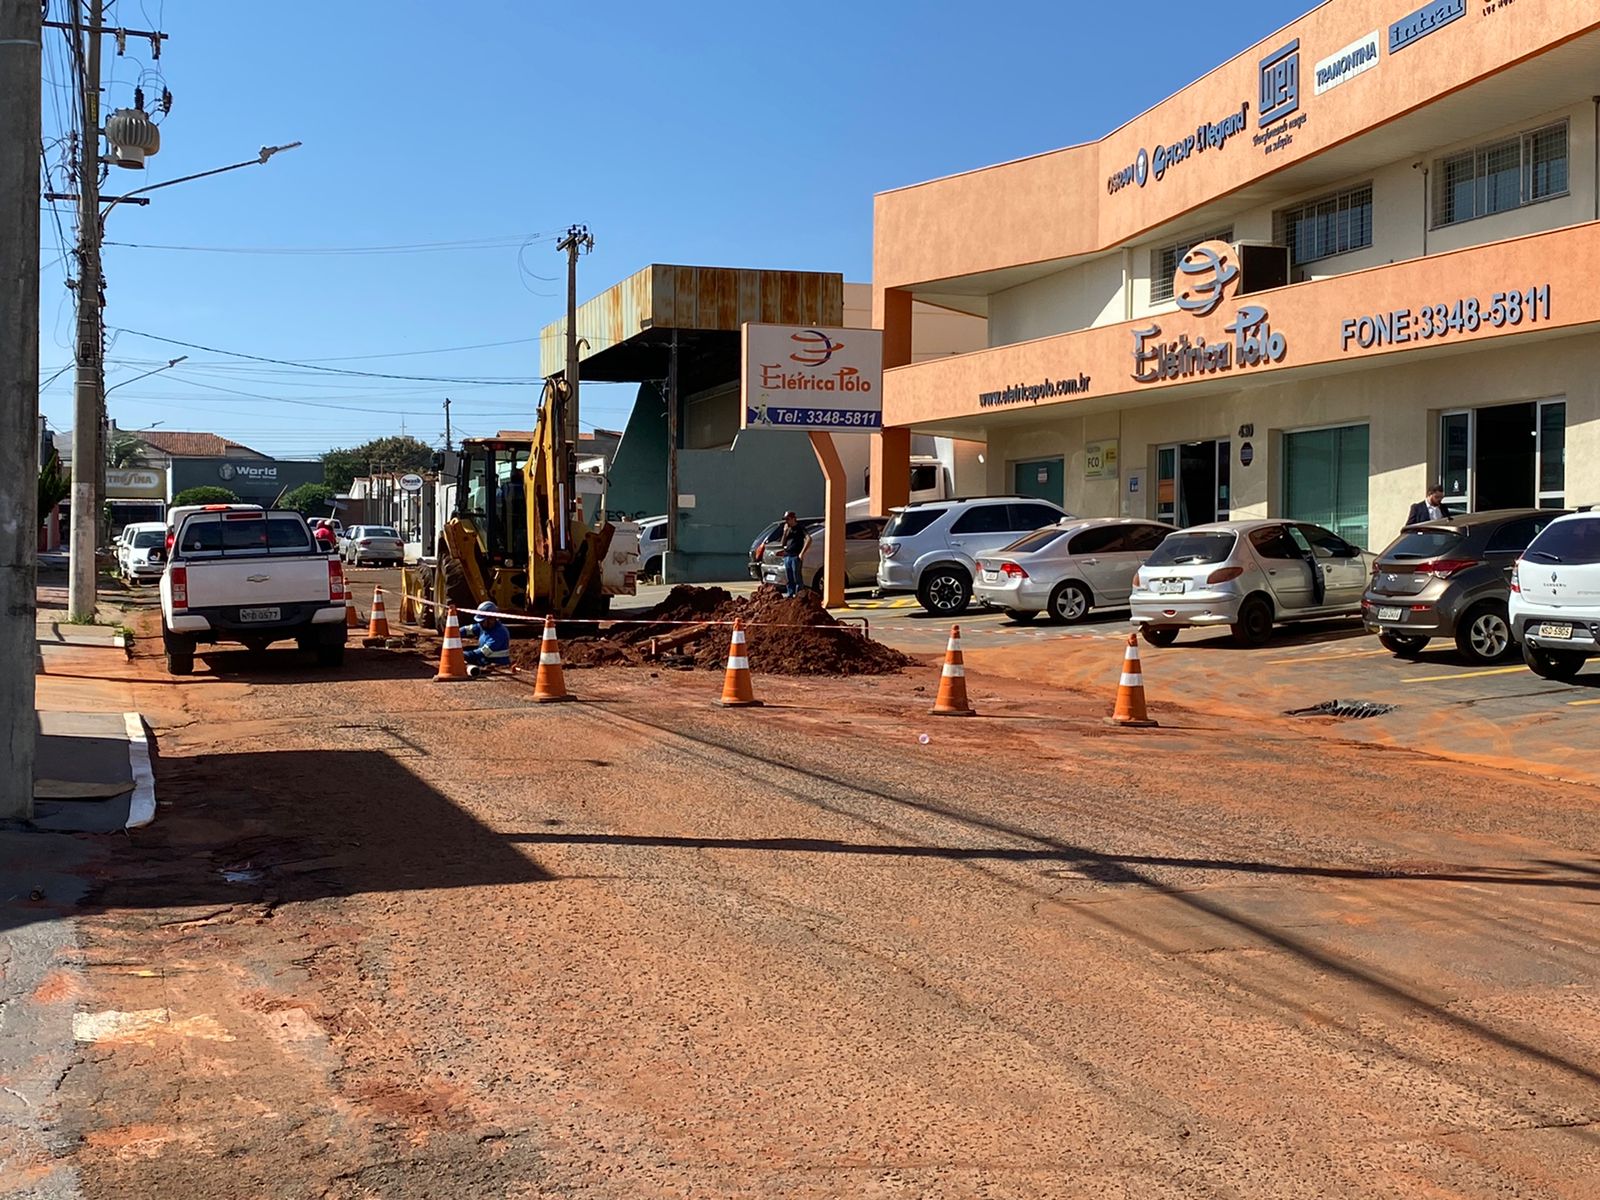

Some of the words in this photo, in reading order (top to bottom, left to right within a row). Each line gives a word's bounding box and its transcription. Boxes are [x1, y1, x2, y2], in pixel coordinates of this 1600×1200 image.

[1316, 41, 1377, 87] TRAMONTINA
[1165, 135, 1195, 168] FICAP
[760, 363, 835, 391] Elétrica
[832, 367, 871, 392] Pólo
[777, 409, 802, 423] Tel:
[806, 411, 877, 426] 3348-5811
[236, 466, 277, 475] World
